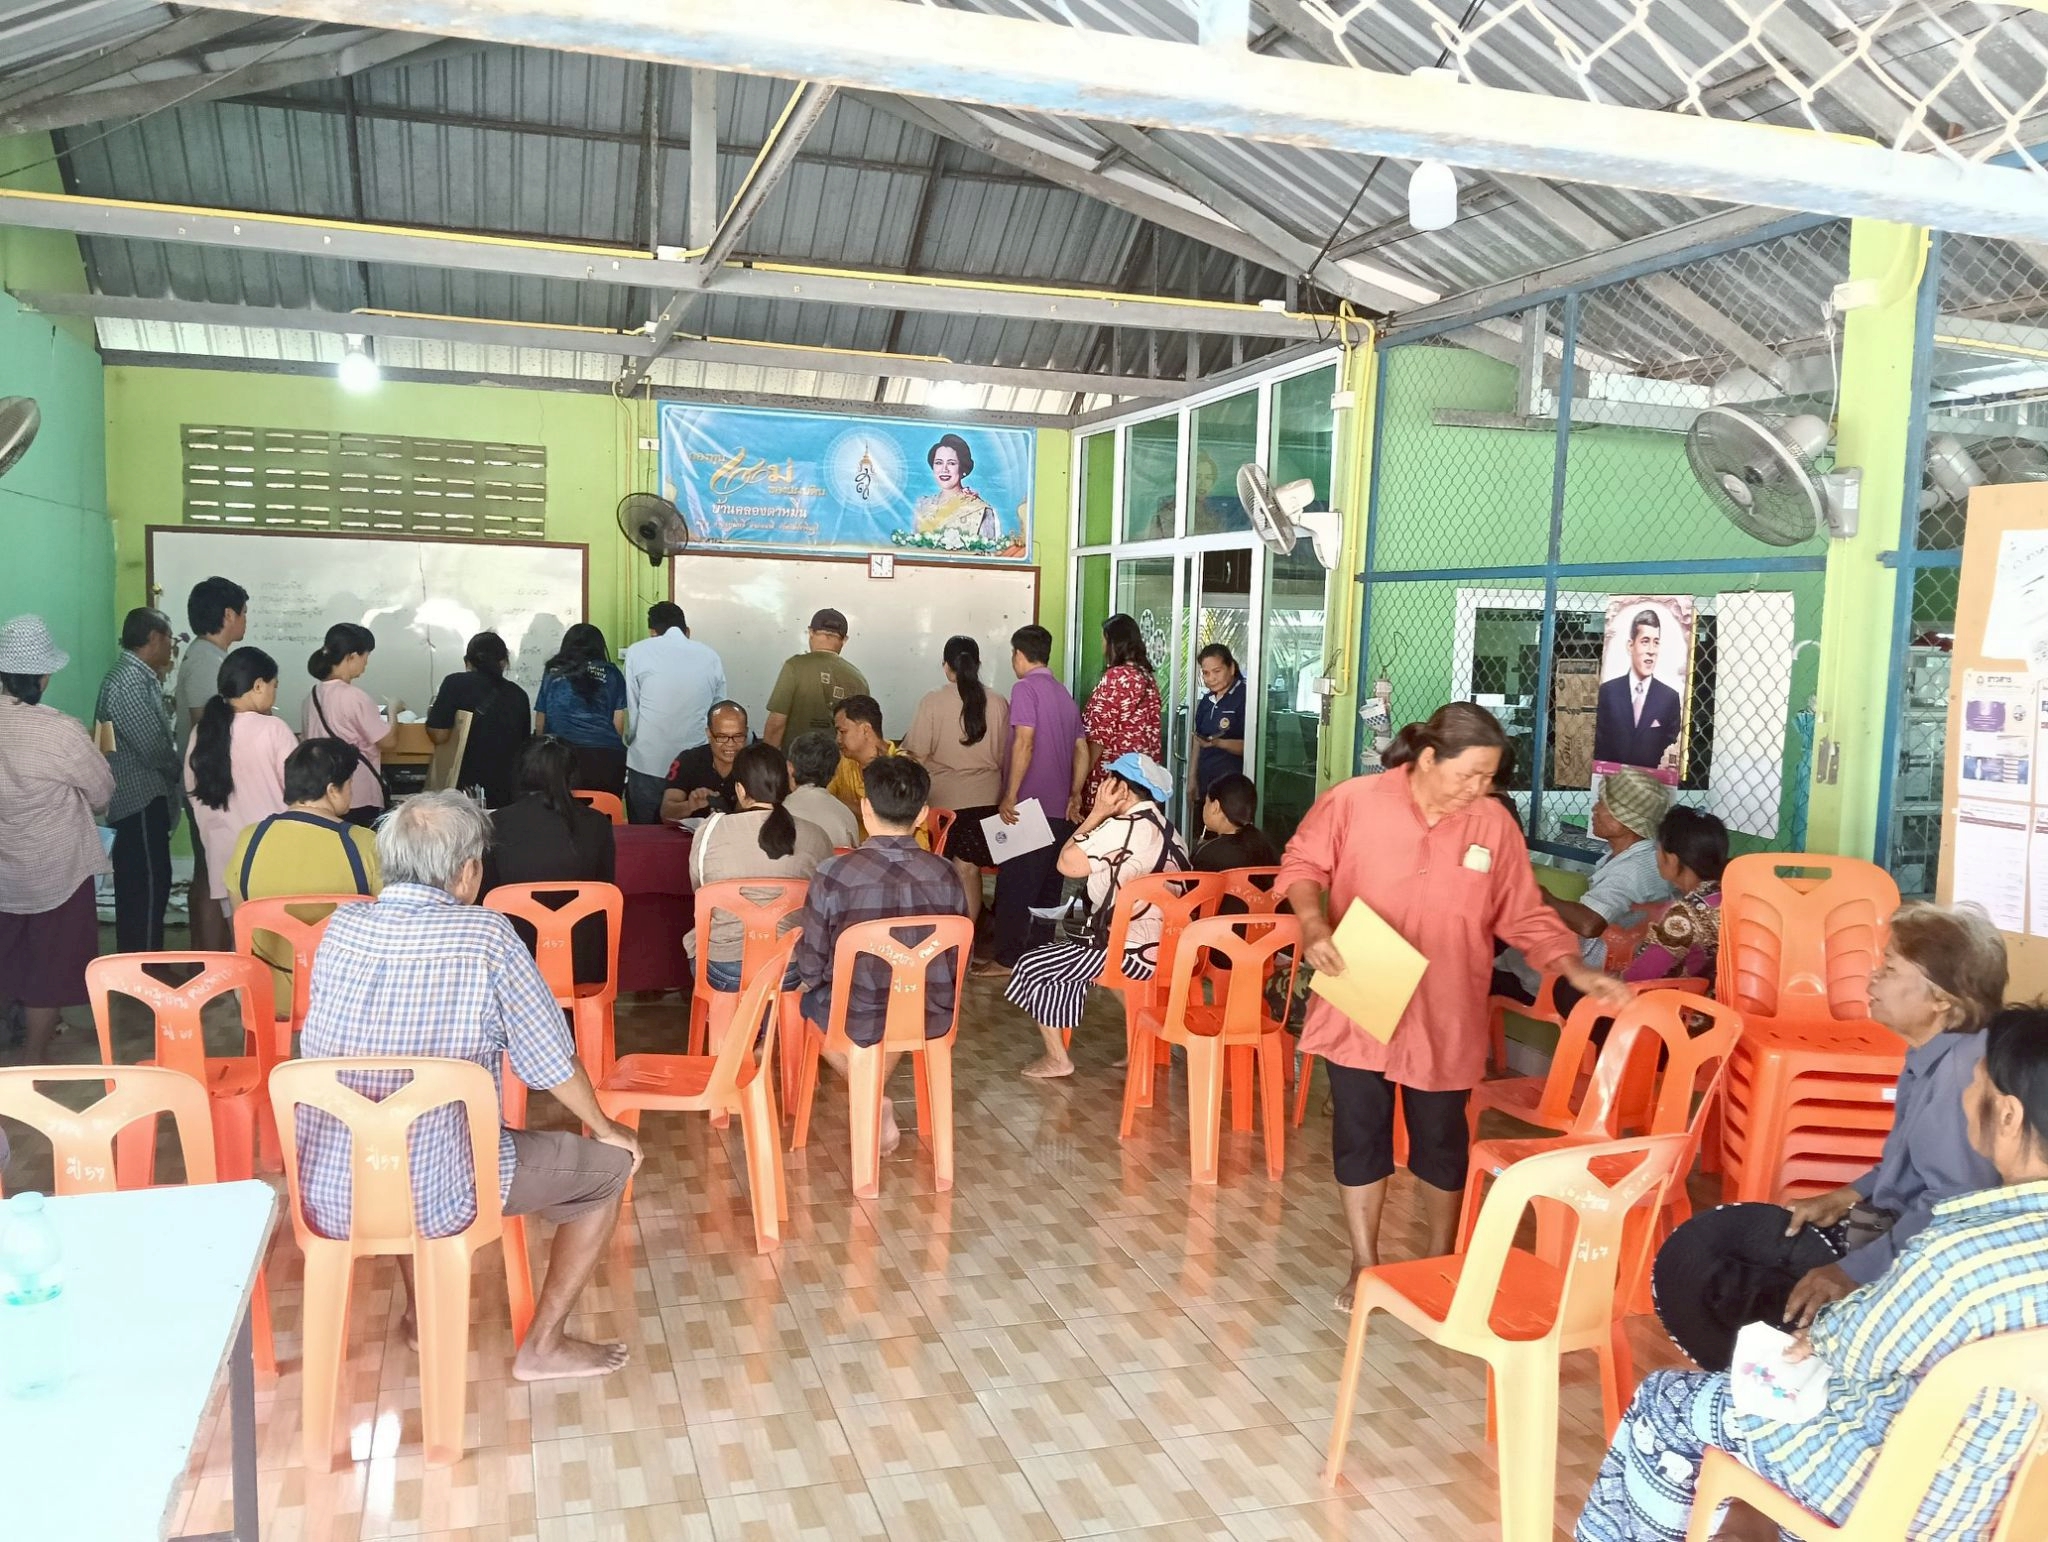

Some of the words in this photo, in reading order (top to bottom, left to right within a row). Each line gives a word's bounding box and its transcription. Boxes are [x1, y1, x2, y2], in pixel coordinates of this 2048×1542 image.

[711, 496, 808, 519] บ้านคลองตาหมื่น
